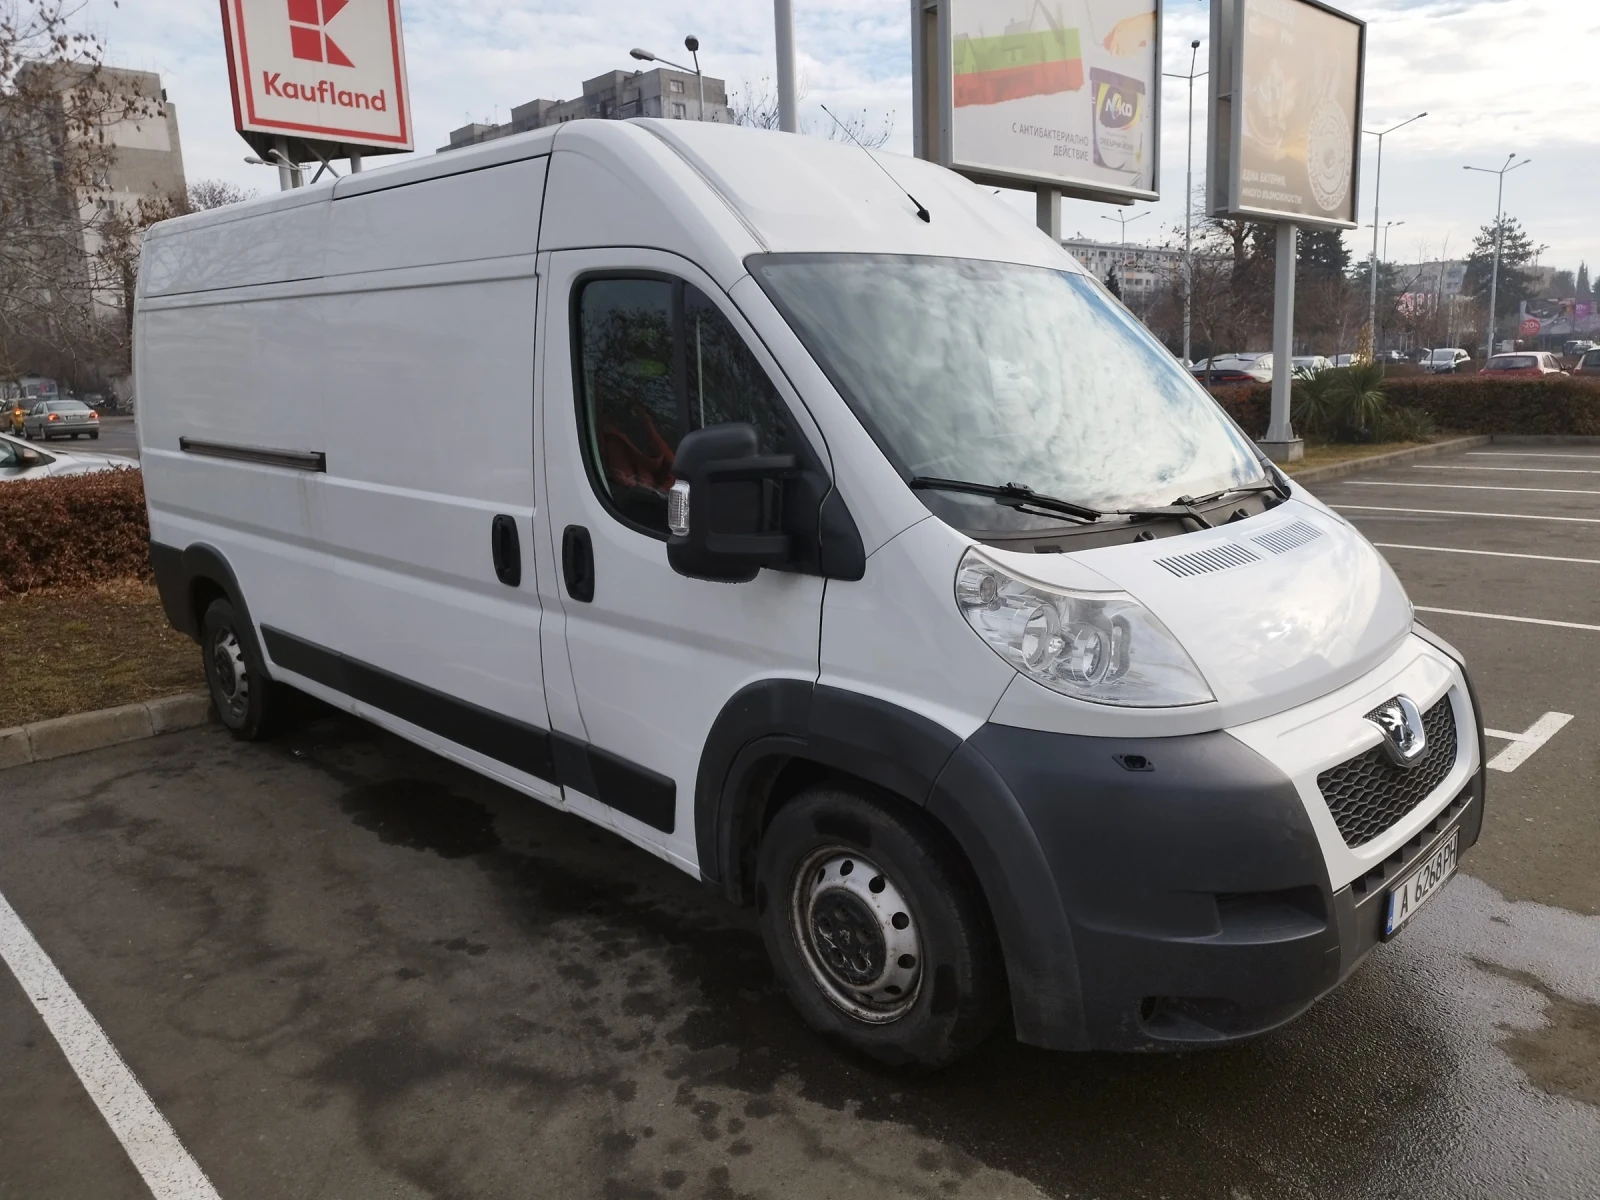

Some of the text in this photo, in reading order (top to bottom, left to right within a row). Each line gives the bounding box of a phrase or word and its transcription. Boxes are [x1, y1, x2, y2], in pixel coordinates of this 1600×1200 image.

[262, 70, 387, 112] Kaufland
[1011, 122, 1018, 133] С
[1019, 123, 1089, 147] АНТИБАКТЕРИАЛНО
[1053, 145, 1089, 161] ДЕЙСТВИЕ
[1400, 884, 1408, 918] A
